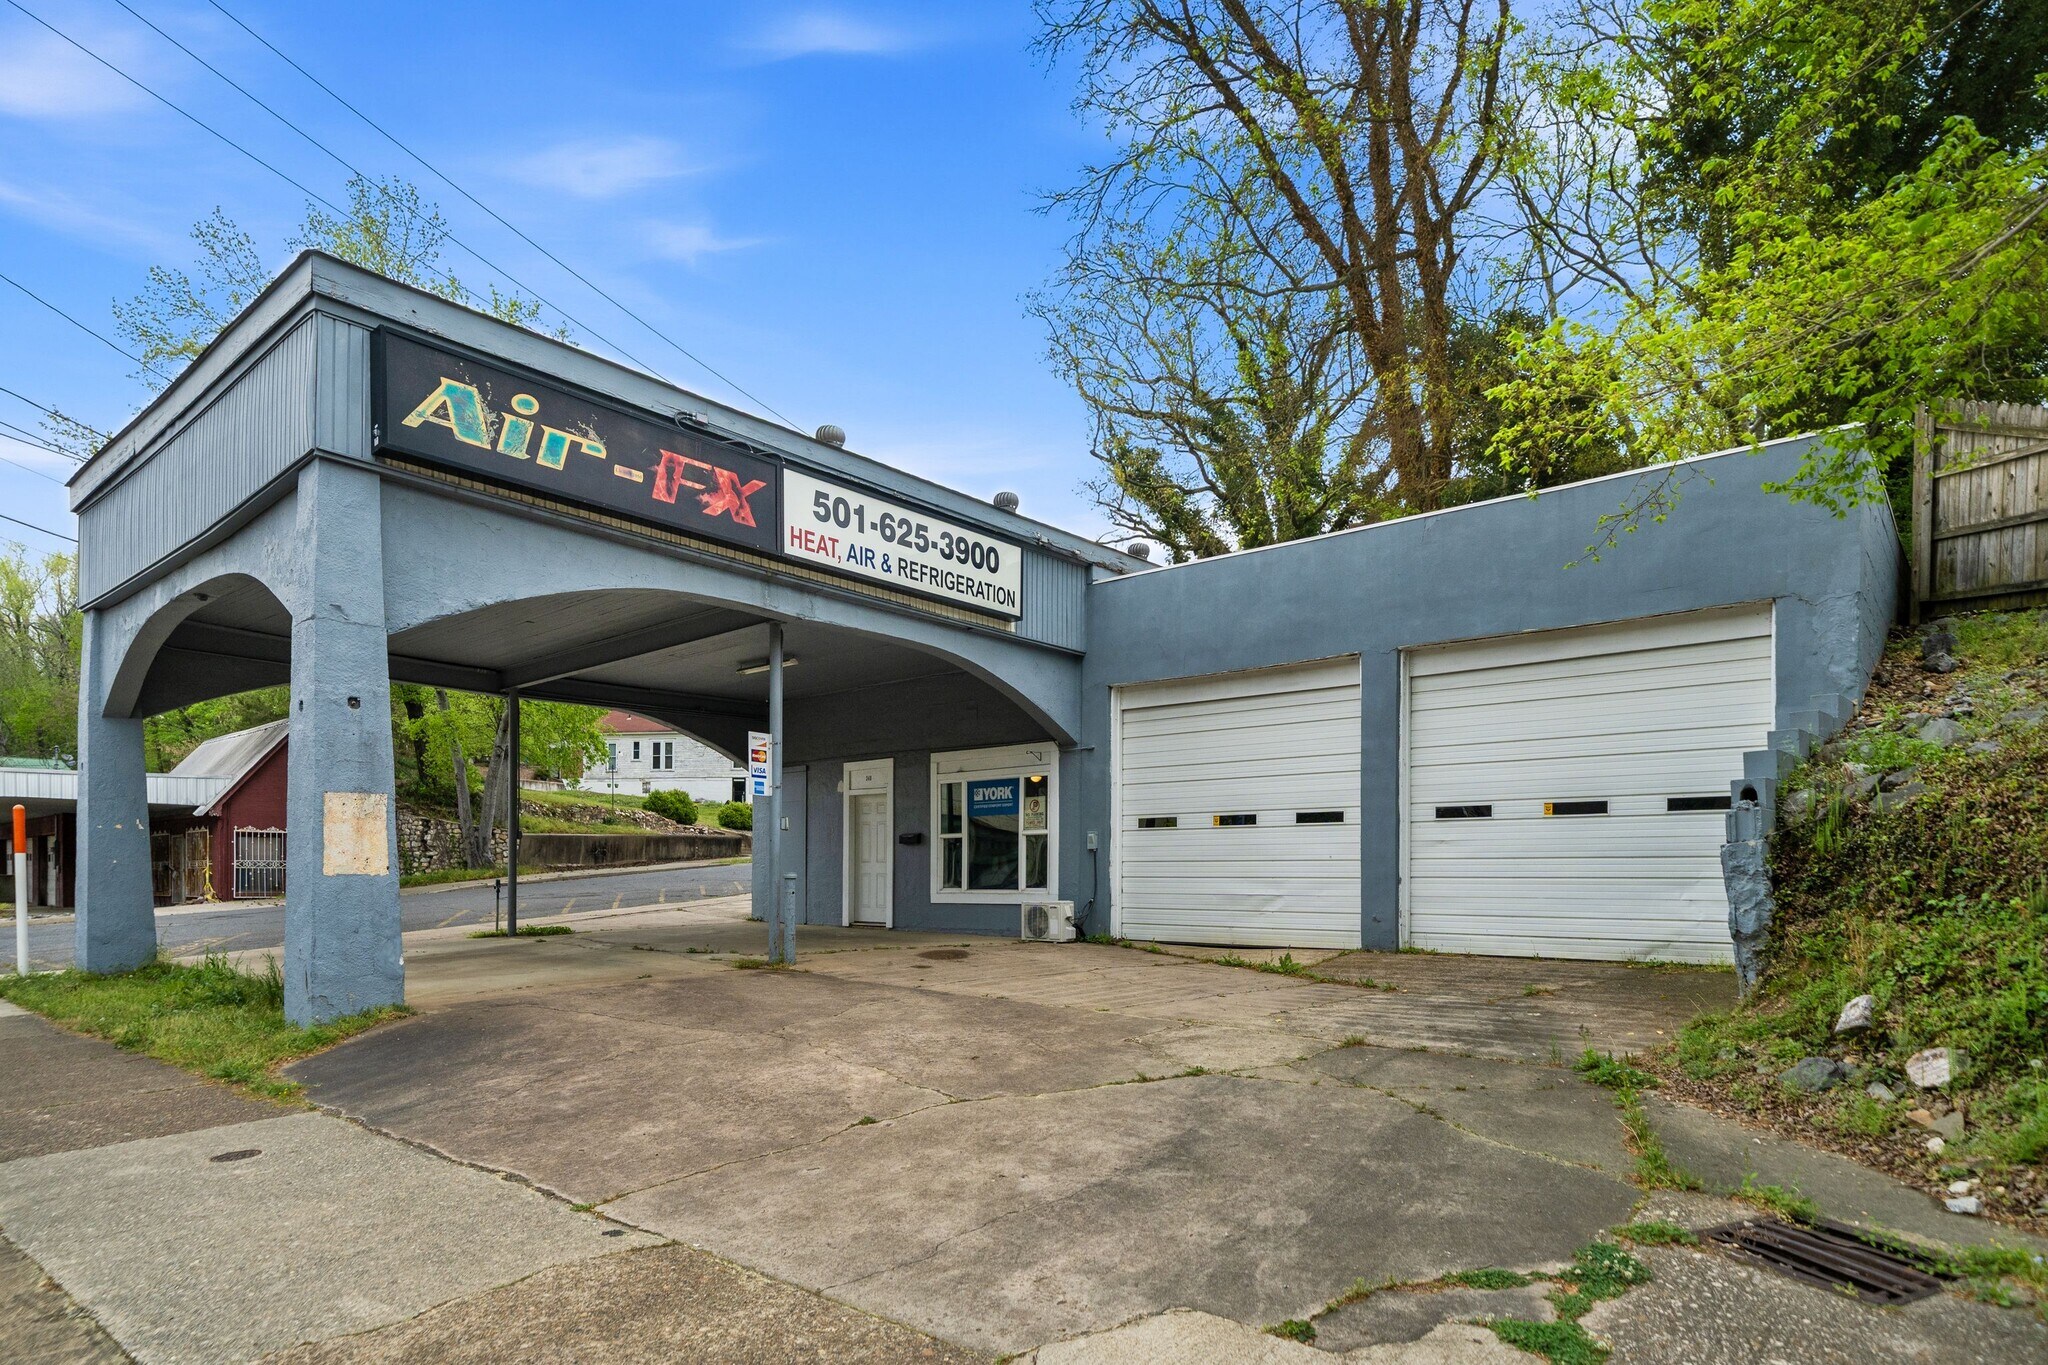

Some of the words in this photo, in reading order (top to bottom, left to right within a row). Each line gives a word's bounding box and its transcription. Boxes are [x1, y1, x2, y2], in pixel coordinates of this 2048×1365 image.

[401, 376, 767, 528] Air-FX
[790, 526, 842, 563] HEAT,
[846, 543, 876, 570] AIR
[881, 553, 892, 574] &
[898, 557, 1016, 608] REFRIGERATION
[812, 490, 1000, 574] 501-625-3900
[983, 787, 1012, 800] YORK
